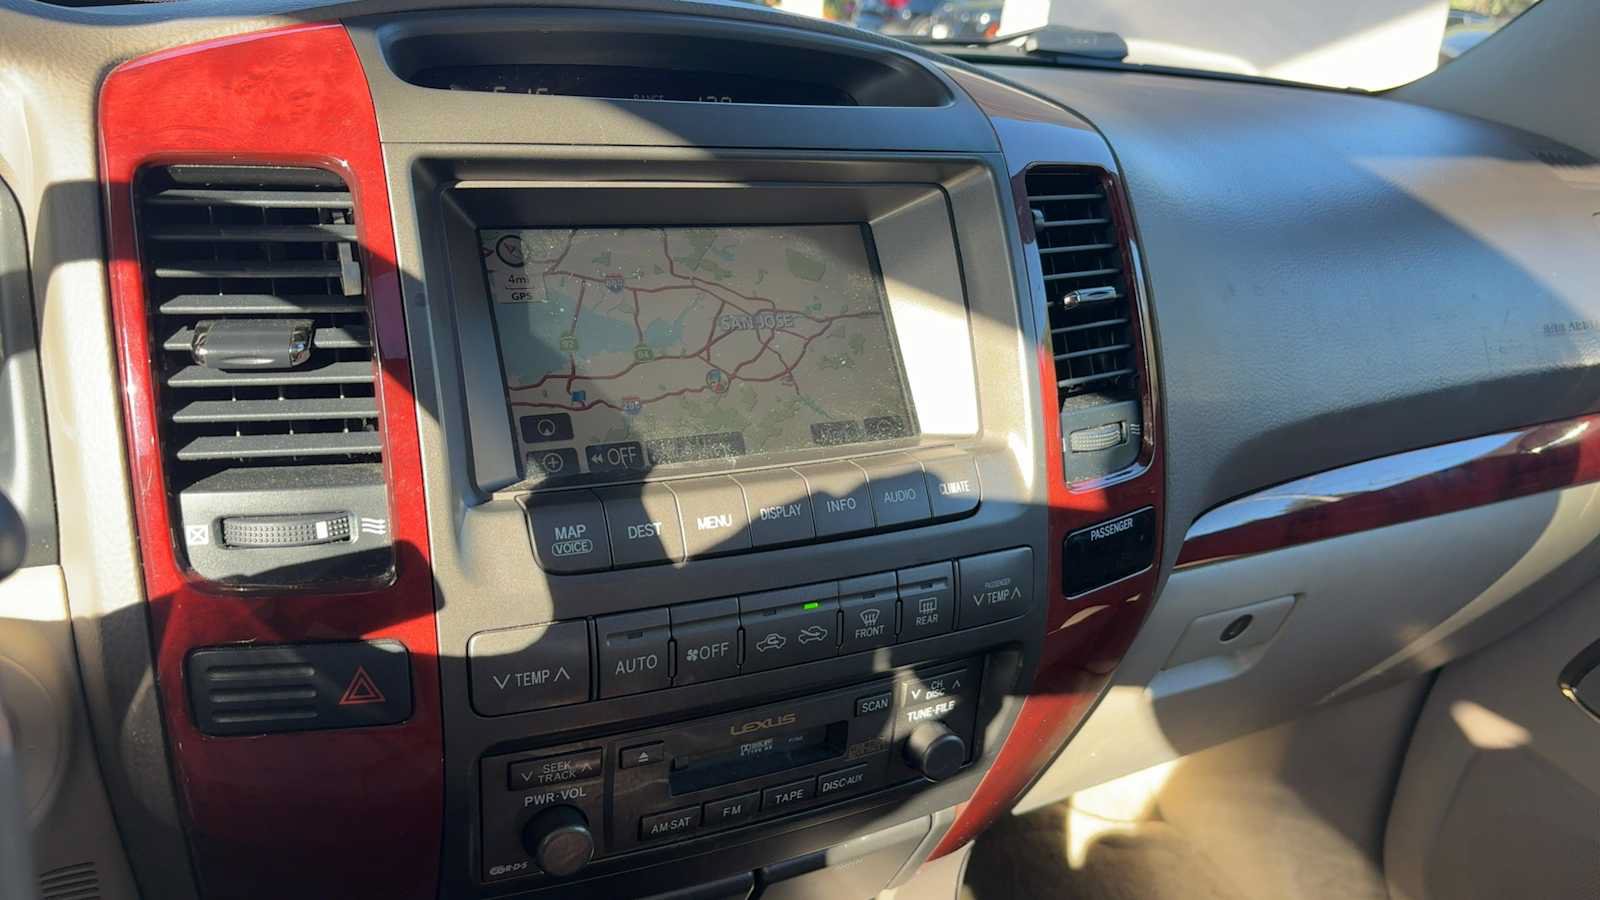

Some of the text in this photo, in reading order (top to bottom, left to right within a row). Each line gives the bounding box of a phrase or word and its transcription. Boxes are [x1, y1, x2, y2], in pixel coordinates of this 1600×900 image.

[511, 292, 532, 301] GPS
[720, 313, 794, 331] SAN JOSE
[607, 446, 636, 466] OFF
[883, 487, 916, 504] AUDIO
[760, 503, 801, 521] DISPLAY
[826, 497, 857, 513] INFO
[628, 521, 663, 539] DEST
[697, 514, 732, 531] MENU
[1090, 518, 1133, 541] PASSENGER
[554, 524, 586, 540] MAP
[555, 541, 589, 554] VOICE
[987, 589, 1010, 605] TEMP
[915, 613, 939, 626] REAR
[855, 624, 885, 639] FRONT
[699, 642, 729, 661] OFF
[615, 654, 658, 675] AUTO
[514, 670, 551, 687] TEMP
[930, 680, 945, 690] CH
[925, 687, 945, 699] DISC
[862, 698, 889, 713] SCAN
[730, 713, 797, 736] LEXUS
[543, 761, 572, 775] SEEK
[538, 769, 576, 784] TRACK
[775, 788, 804, 804] TAPE
[723, 804, 742, 817] FM
